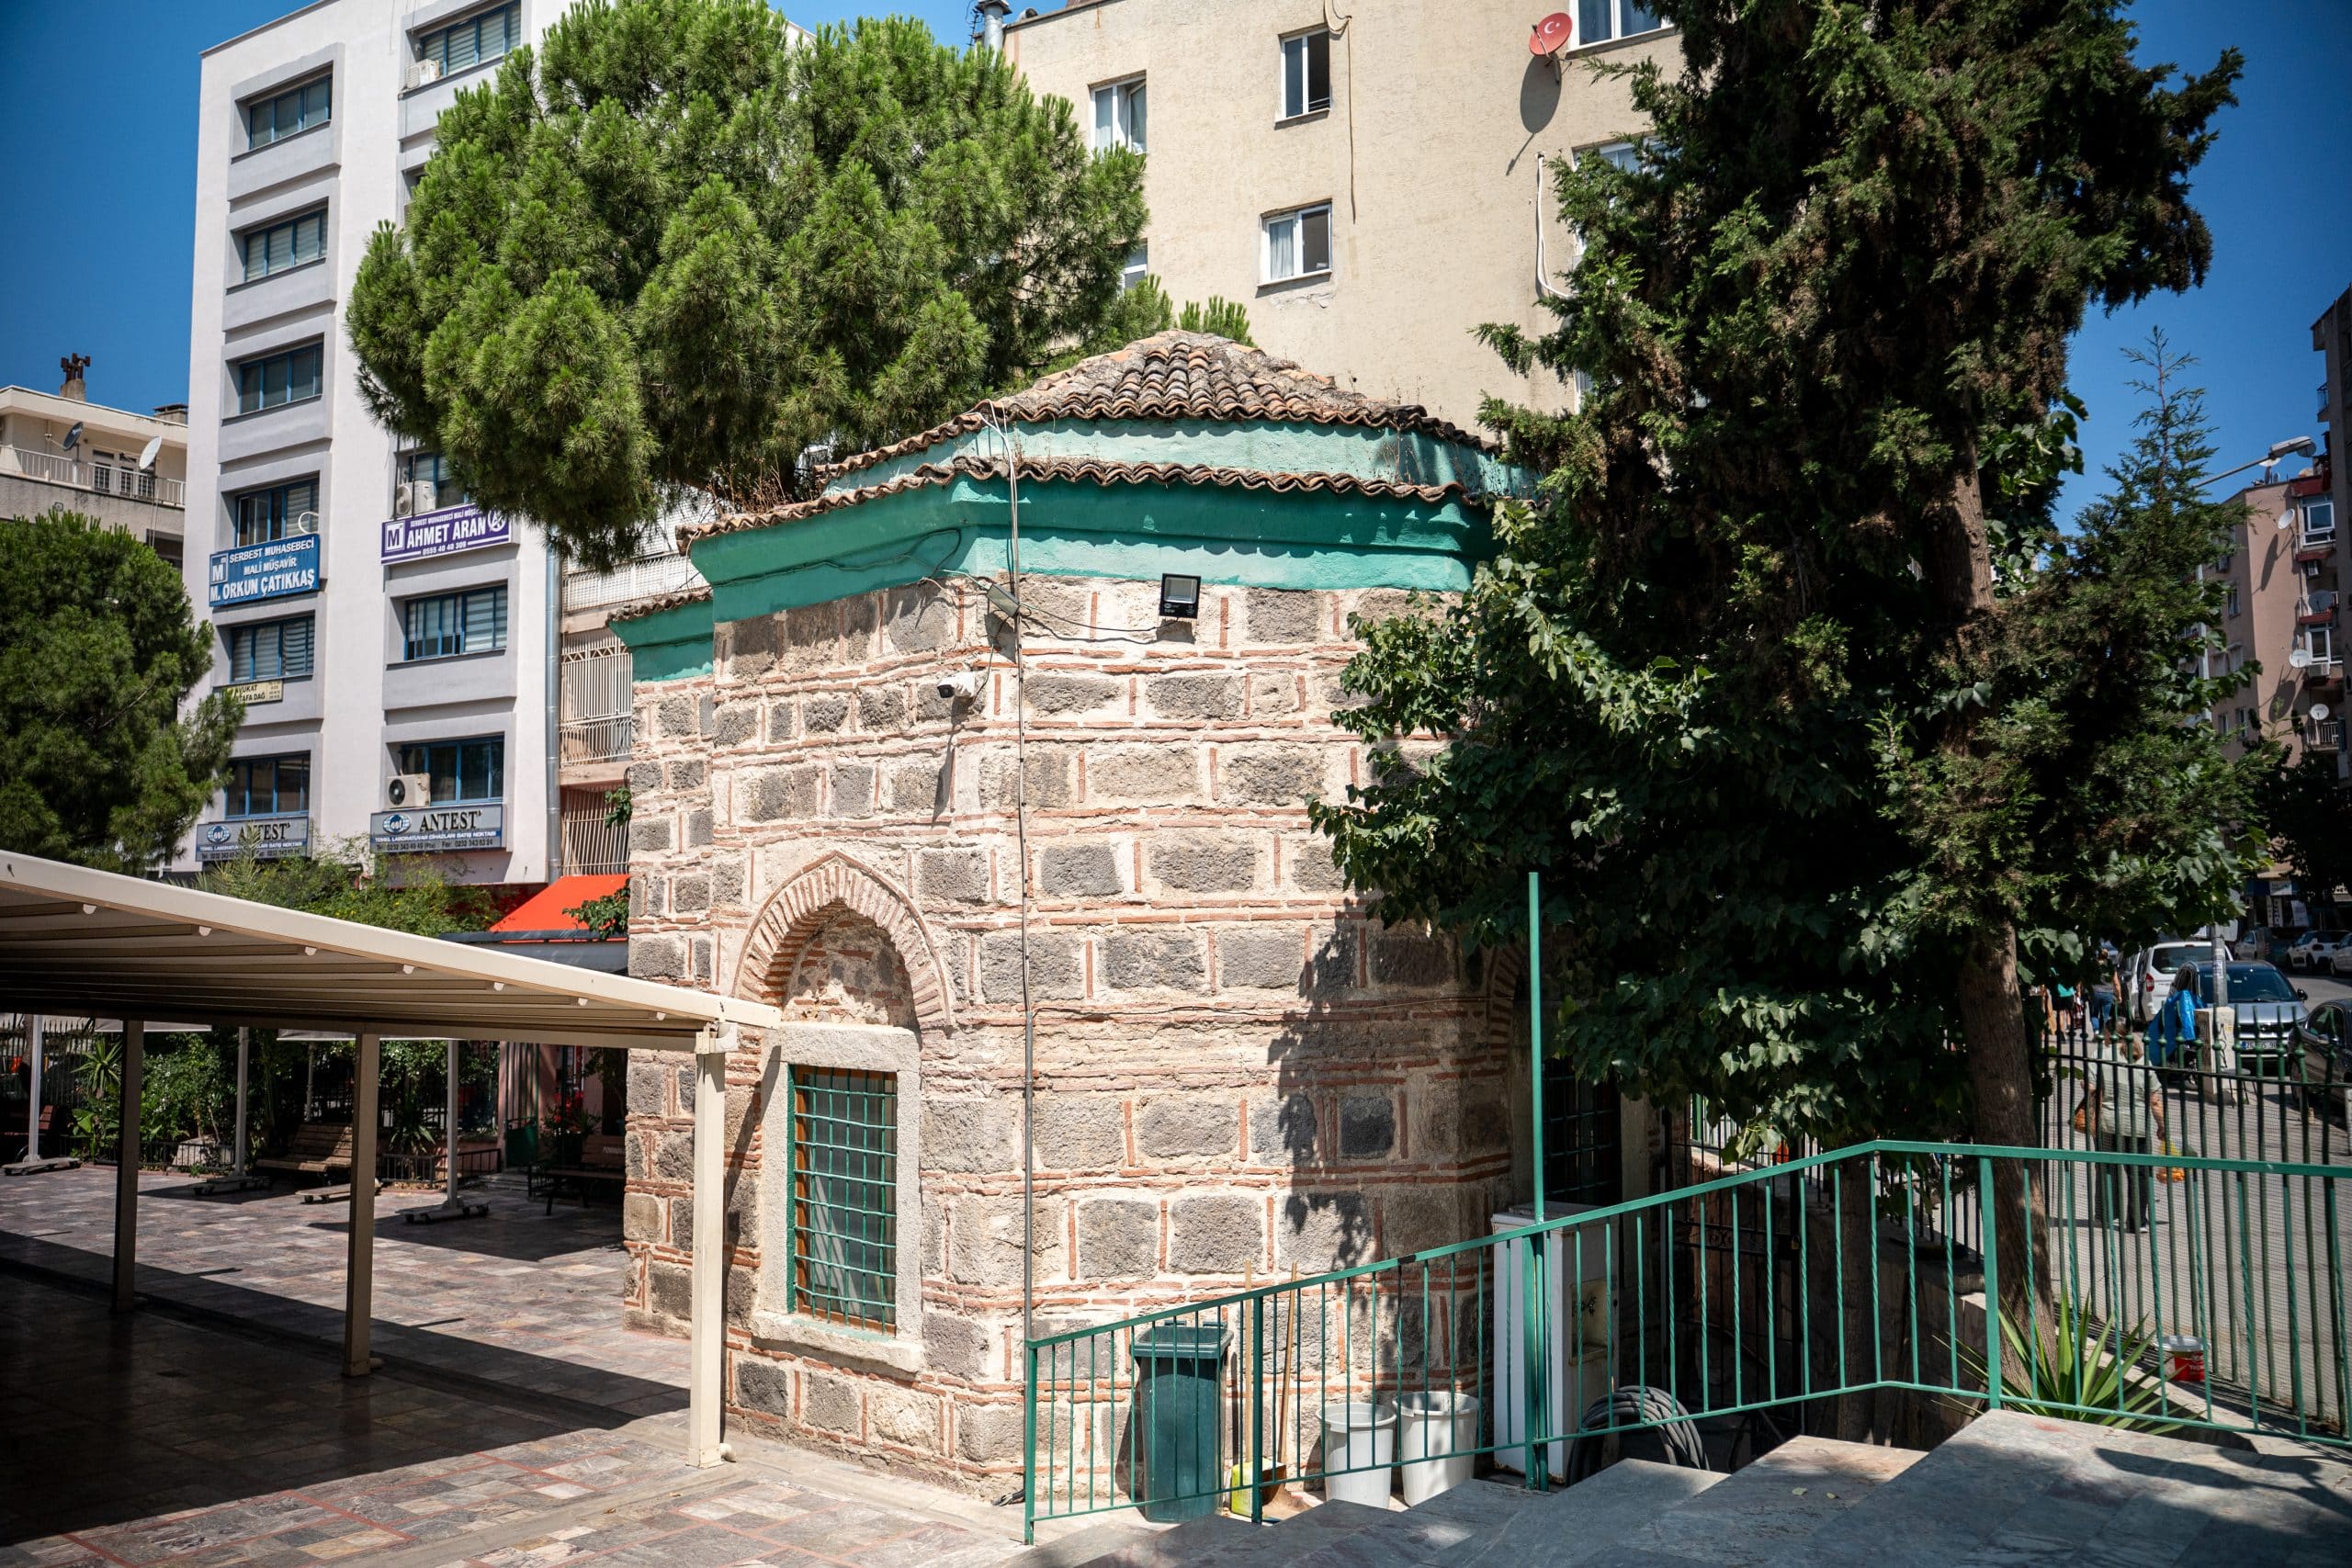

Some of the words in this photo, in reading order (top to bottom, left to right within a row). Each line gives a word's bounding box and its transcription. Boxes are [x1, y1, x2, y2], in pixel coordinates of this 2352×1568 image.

[406, 523, 450, 548] AHMET
[452, 516, 486, 540] ARAN
[229, 548, 263, 564] SERBEST
[265, 536, 314, 557] MUHASEBECİ
[243, 560, 262, 576] MALİ
[263, 555, 298, 572] MÜŞAVİR
[209, 584, 220, 603] M.
[222, 578, 258, 601] ORKUN
[260, 568, 315, 596] ÇATIKKAŞ
[254, 691, 266, 700] DAĞ
[420, 811, 478, 832] ANTEST
